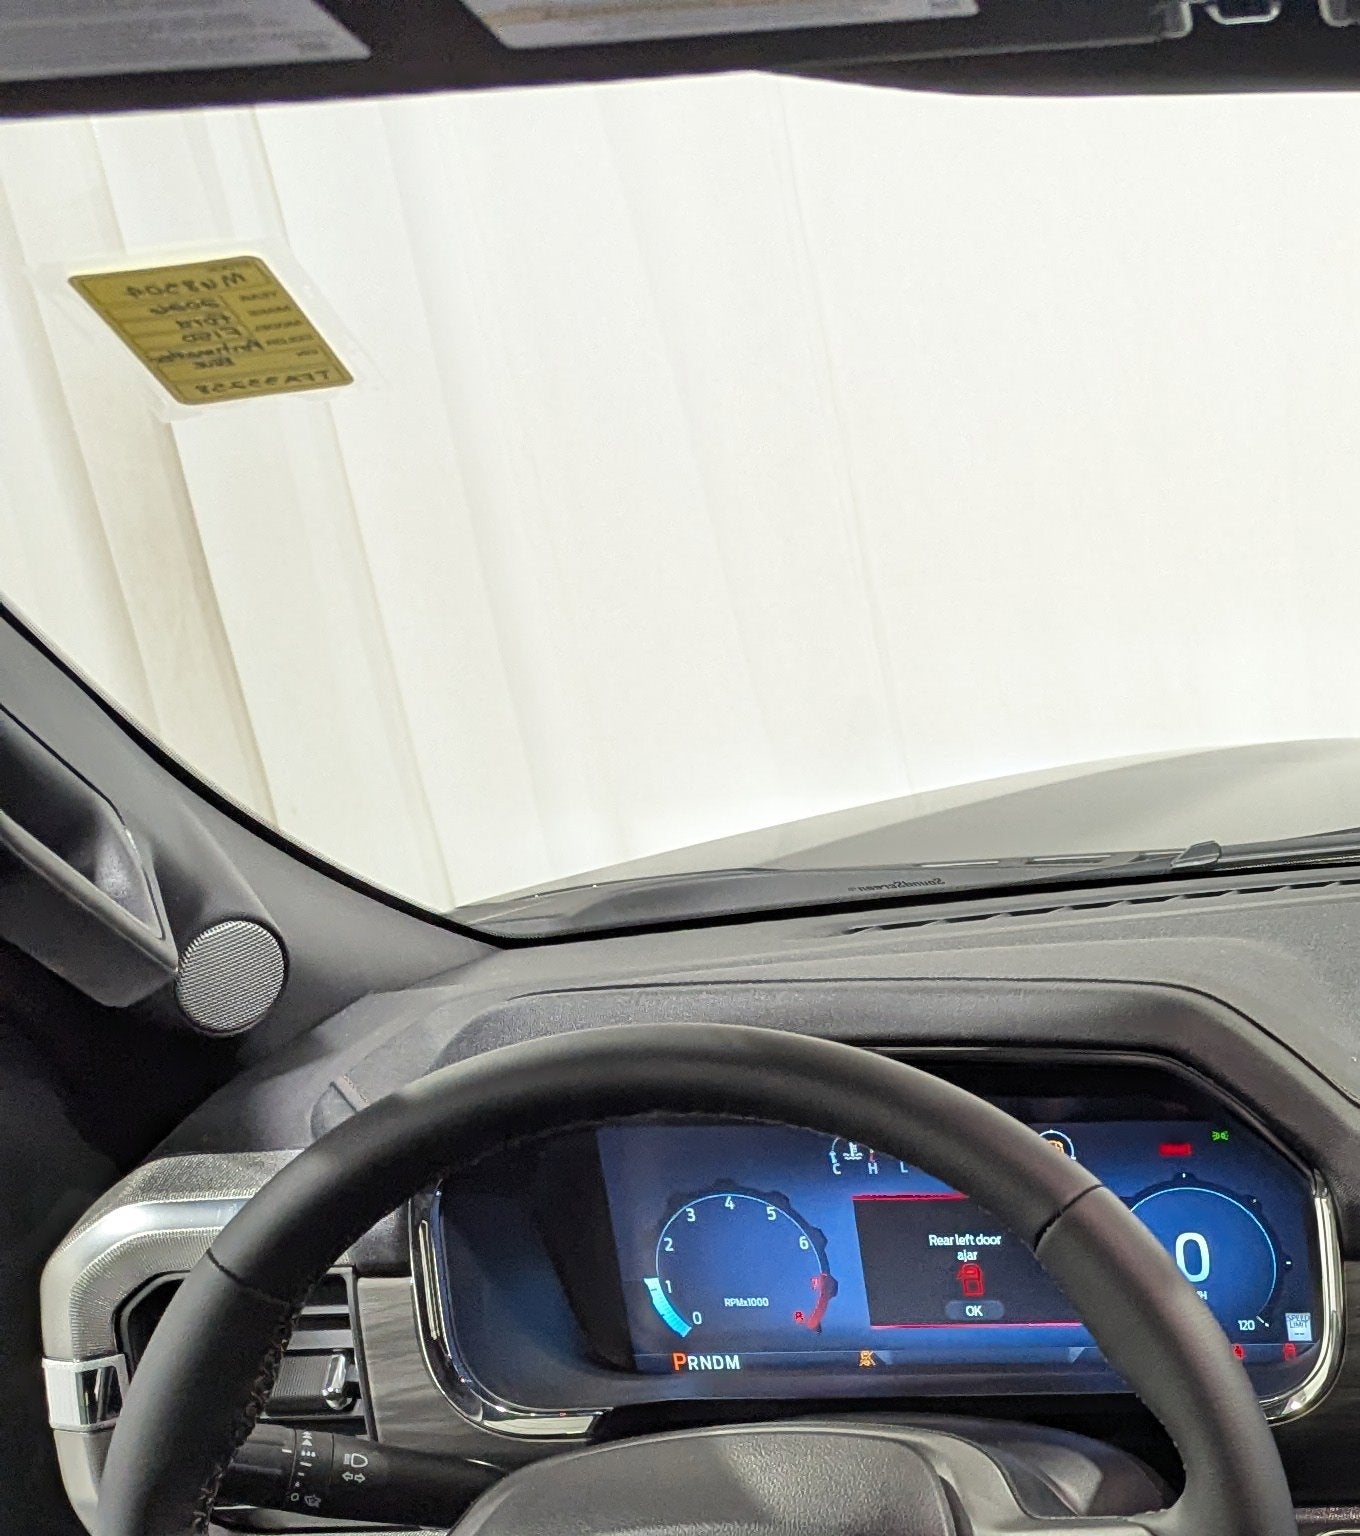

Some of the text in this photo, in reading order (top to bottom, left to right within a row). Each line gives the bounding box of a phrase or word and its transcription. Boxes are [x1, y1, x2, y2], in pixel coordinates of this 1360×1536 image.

[832, 1163, 842, 1175] C
[868, 1163, 878, 1175] H
[725, 1196, 735, 1210] 4
[686, 1208, 696, 1222] 3
[766, 1206, 777, 1221] 5
[664, 1238, 674, 1251] 2
[799, 1236, 809, 1250] 6
[928, 1234, 1002, 1246] Rear left door
[957, 1250, 978, 1262] ajar
[1175, 1232, 1210, 1283] 0
[665, 1280, 672, 1294] 1
[724, 1297, 769, 1308] RPMx1000
[965, 1305, 983, 1317] OK
[692, 1311, 702, 1325] 0
[1287, 1314, 1311, 1322] SPEED
[1237, 1319, 1255, 1331] 120
